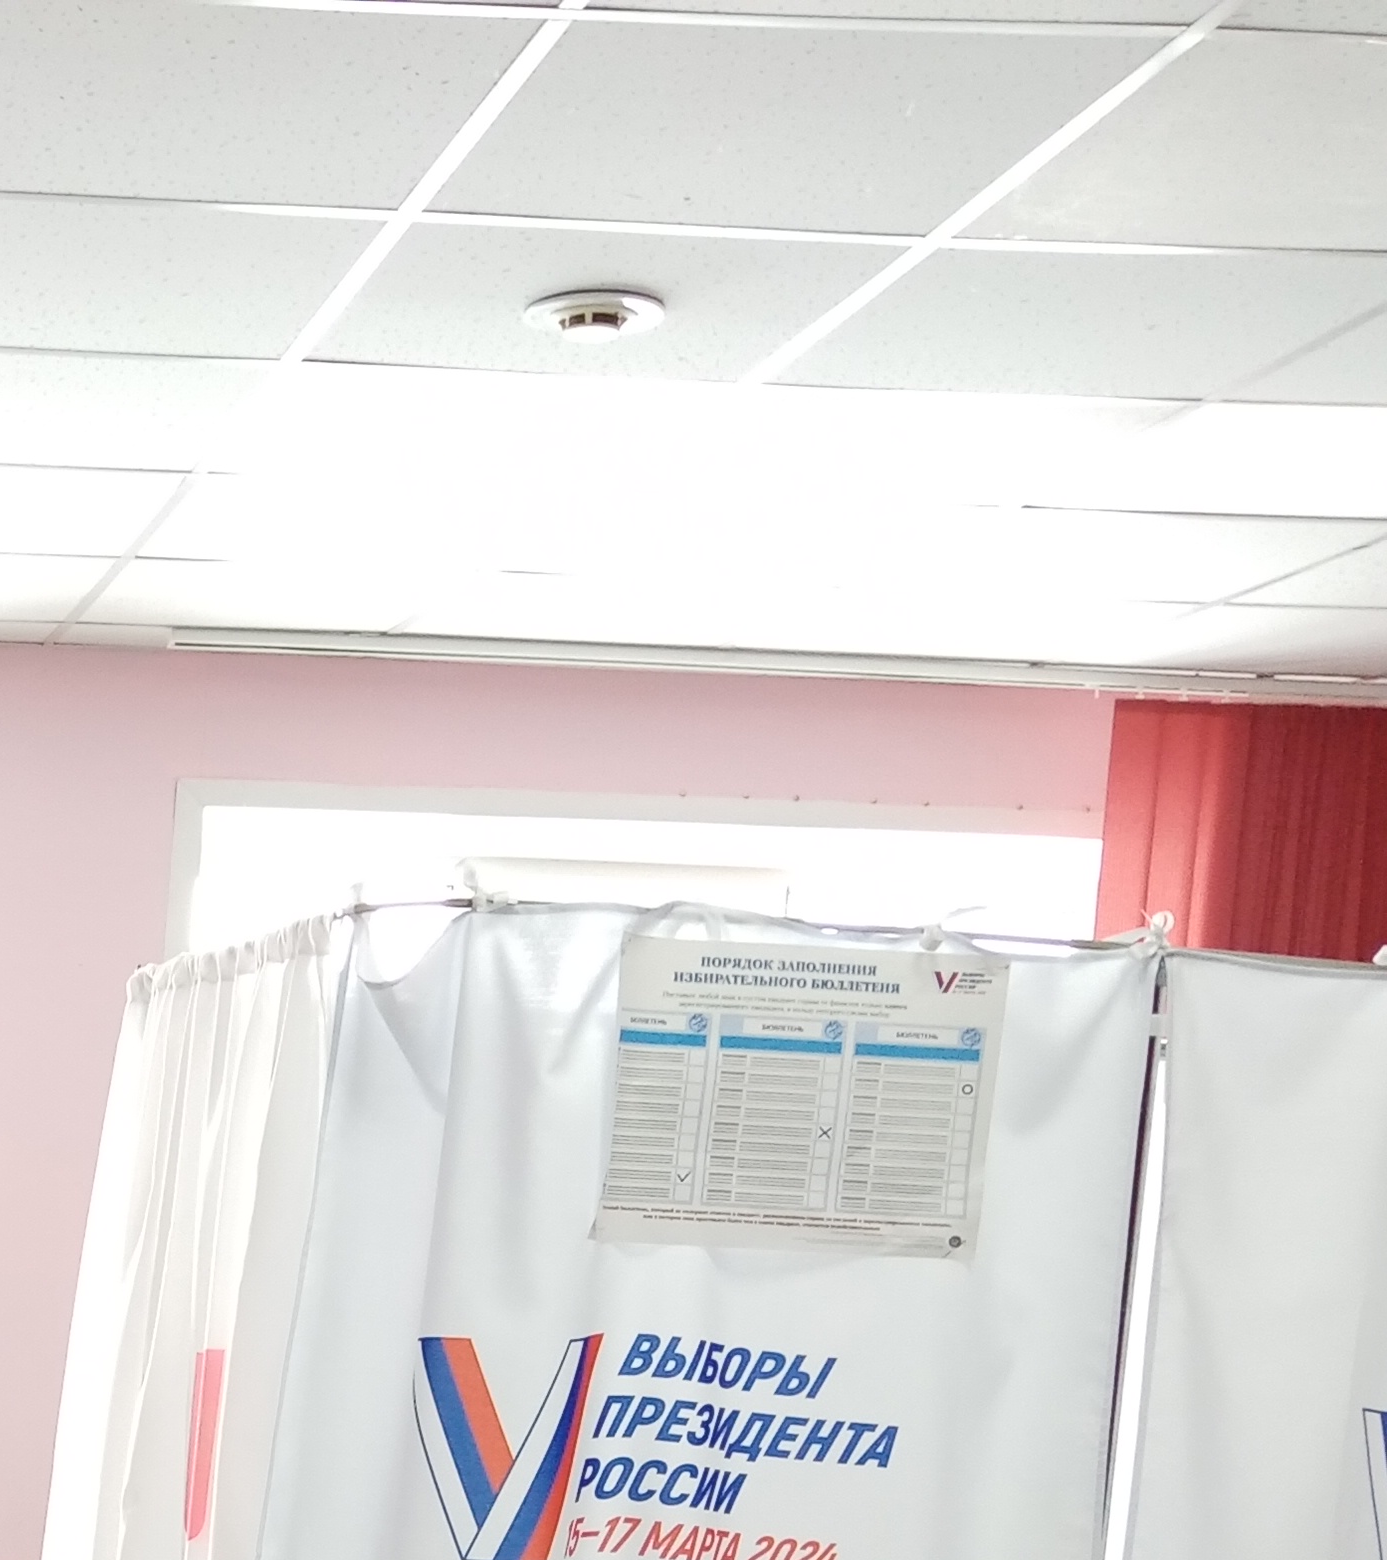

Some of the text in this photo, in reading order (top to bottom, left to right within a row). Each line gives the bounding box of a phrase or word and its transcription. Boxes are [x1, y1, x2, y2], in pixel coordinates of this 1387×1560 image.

[673, 971, 901, 995] ИЗБИРАТЕЛЬНОГО БЮЛЛЕТЕНЯ
[700, 955, 878, 977] ПОРЯДОК ЗАПОЛНЕНИЯ
[617, 1333, 838, 1399] ВЫБОРЫ
[592, 1395, 899, 1468] ПРЕЗИДЕНТА
[574, 1456, 748, 1514] РОССИИ
